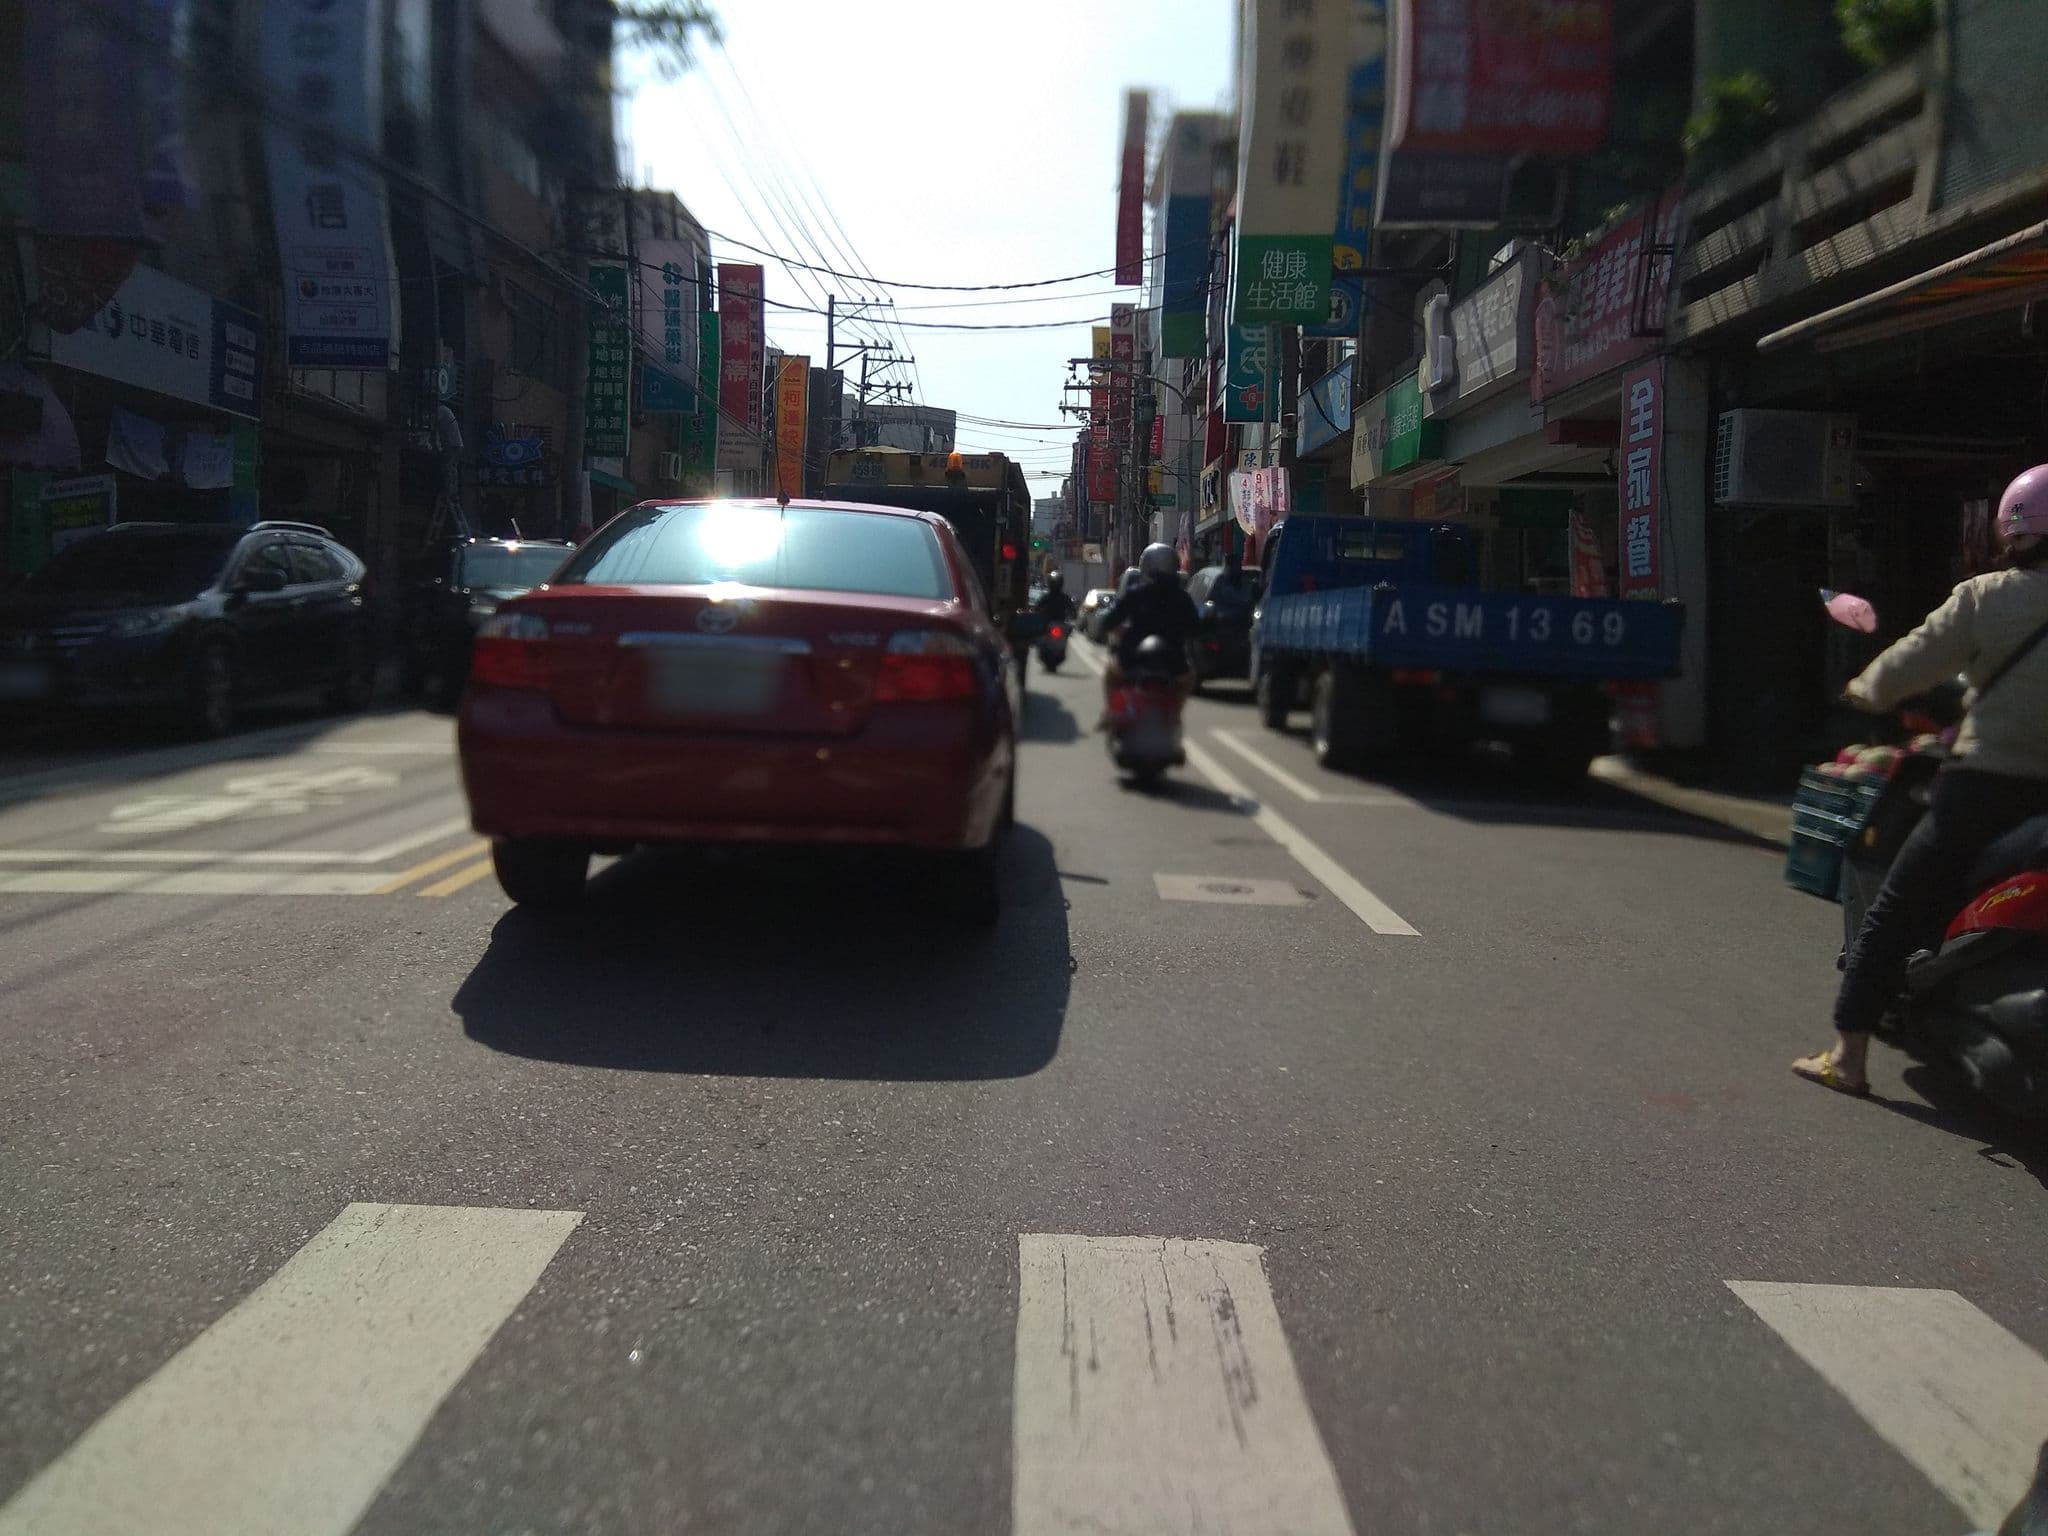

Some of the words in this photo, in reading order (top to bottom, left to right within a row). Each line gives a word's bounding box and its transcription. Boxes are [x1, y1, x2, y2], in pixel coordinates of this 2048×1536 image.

[1261, 249, 1307, 280] 健康
[1246, 280, 1318, 310] 生活館
[1383, 600, 1407, 635] A
[1572, 610, 1625, 645] 69
